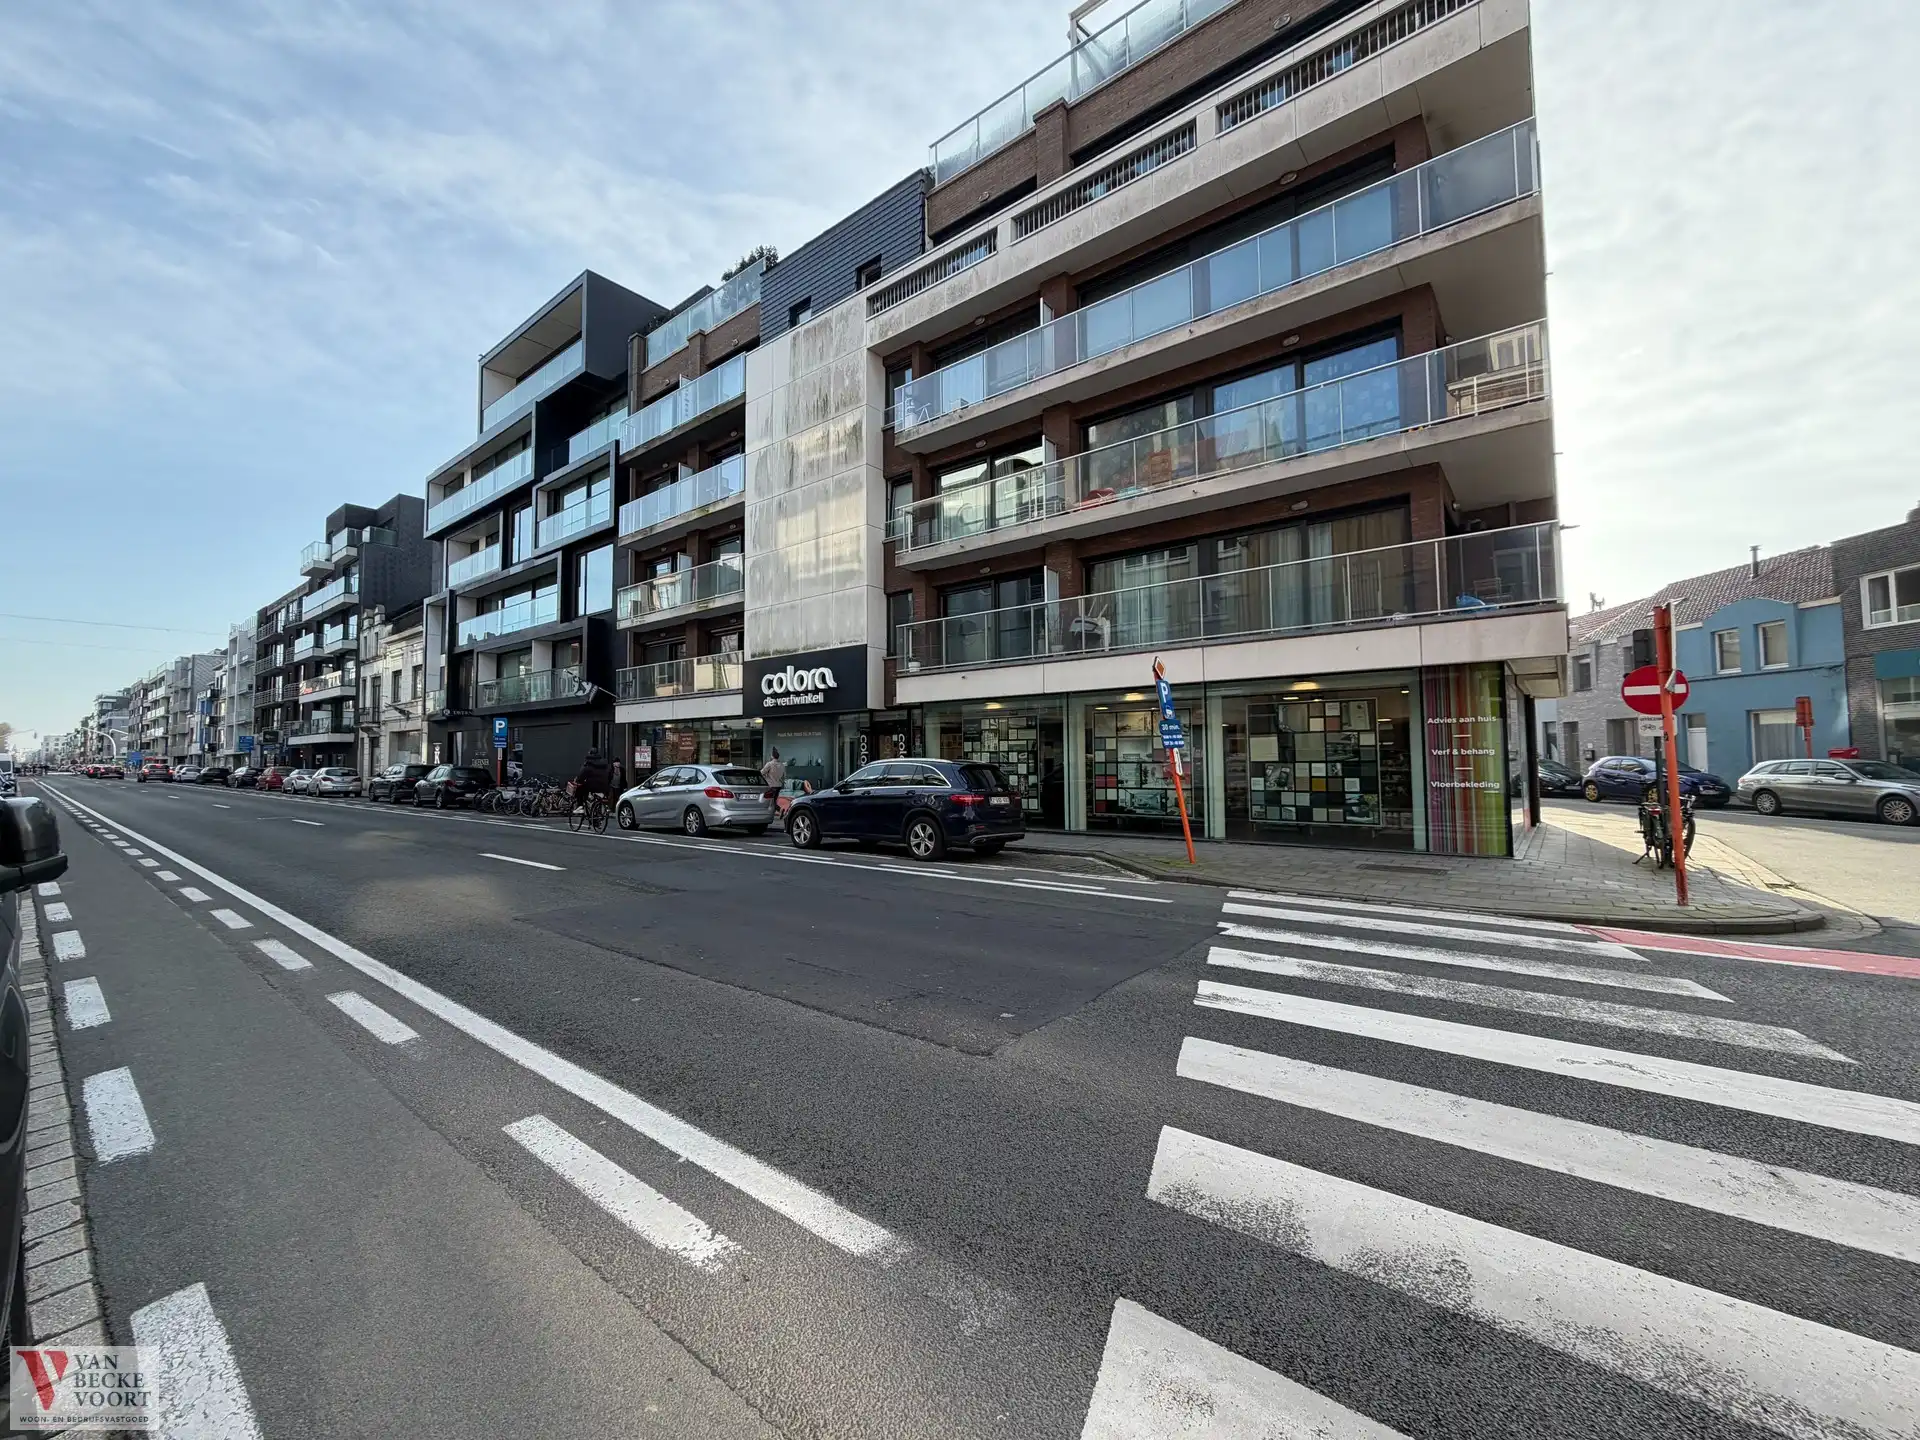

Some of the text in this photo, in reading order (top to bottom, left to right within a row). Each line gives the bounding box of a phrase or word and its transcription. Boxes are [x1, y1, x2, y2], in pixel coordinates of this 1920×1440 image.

[761, 665, 837, 695] colora
[1160, 682, 1169, 703] P
[776, 691, 824, 706] verfwinkel
[1427, 716, 1457, 724] Advies
[495, 720, 506, 734] P
[1161, 723, 1169, 731] 30
[1431, 748, 1450, 756] Verf
[1460, 748, 1496, 756] behang
[1430, 781, 1501, 789] Vloerbekleding
